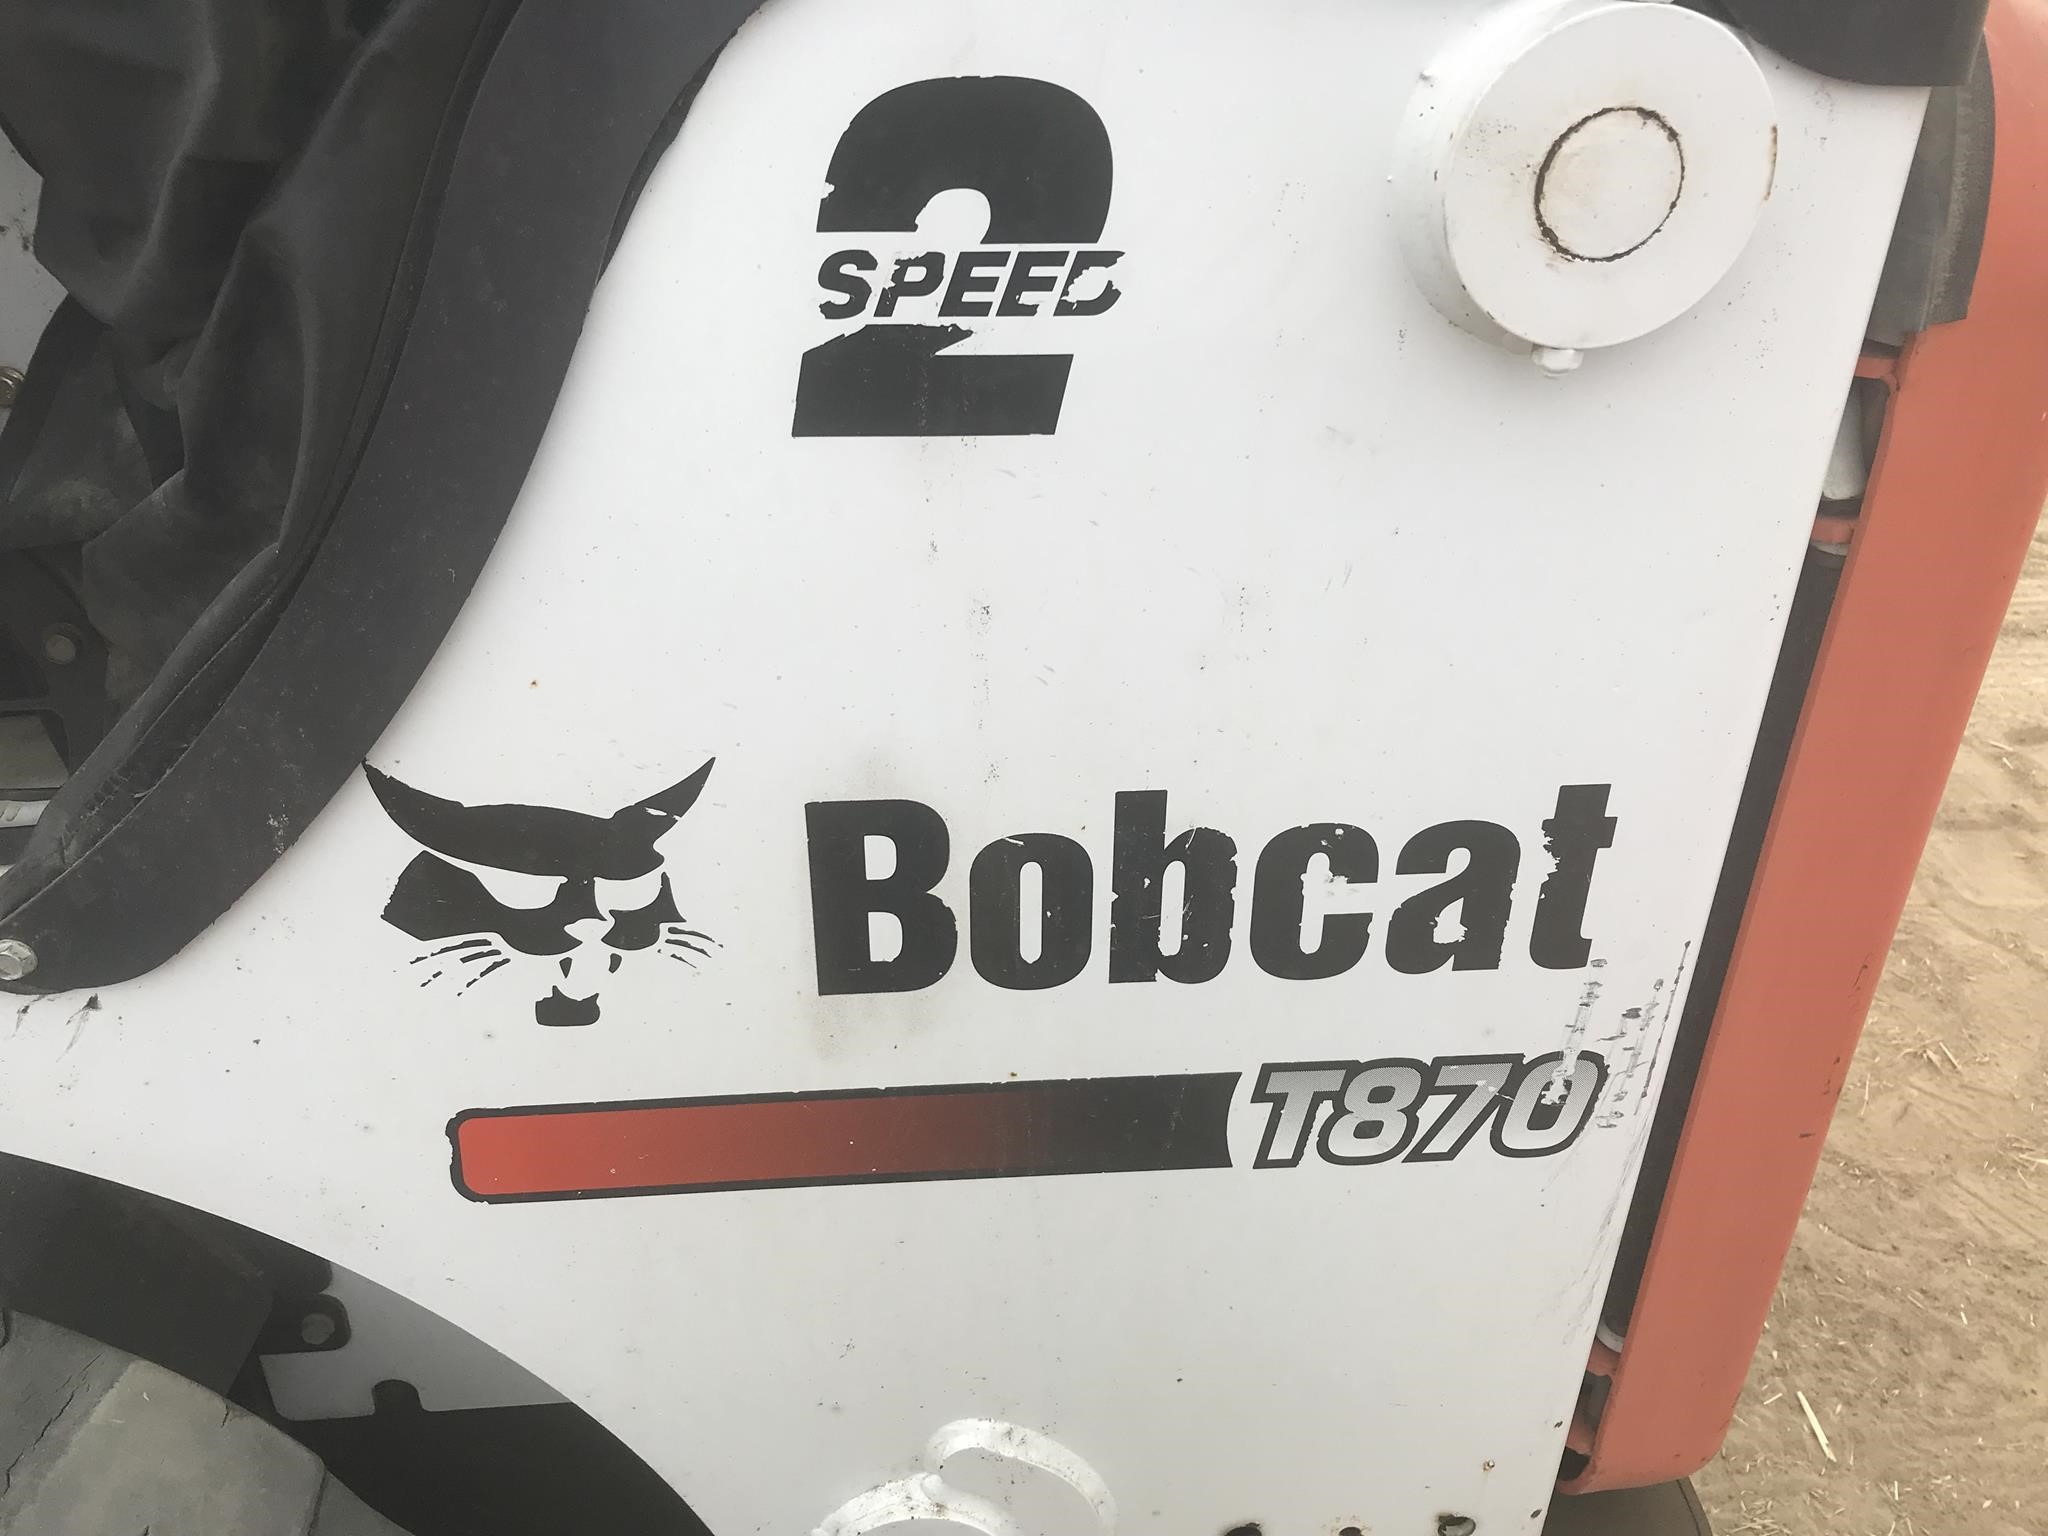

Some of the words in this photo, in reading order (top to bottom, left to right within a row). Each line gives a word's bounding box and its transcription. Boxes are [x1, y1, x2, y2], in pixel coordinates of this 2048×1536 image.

[792, 75, 1113, 437] 2
[818, 249, 1126, 319] SPEED
[805, 784, 1618, 996] Bobcat
[1250, 1050, 1609, 1169] T870
